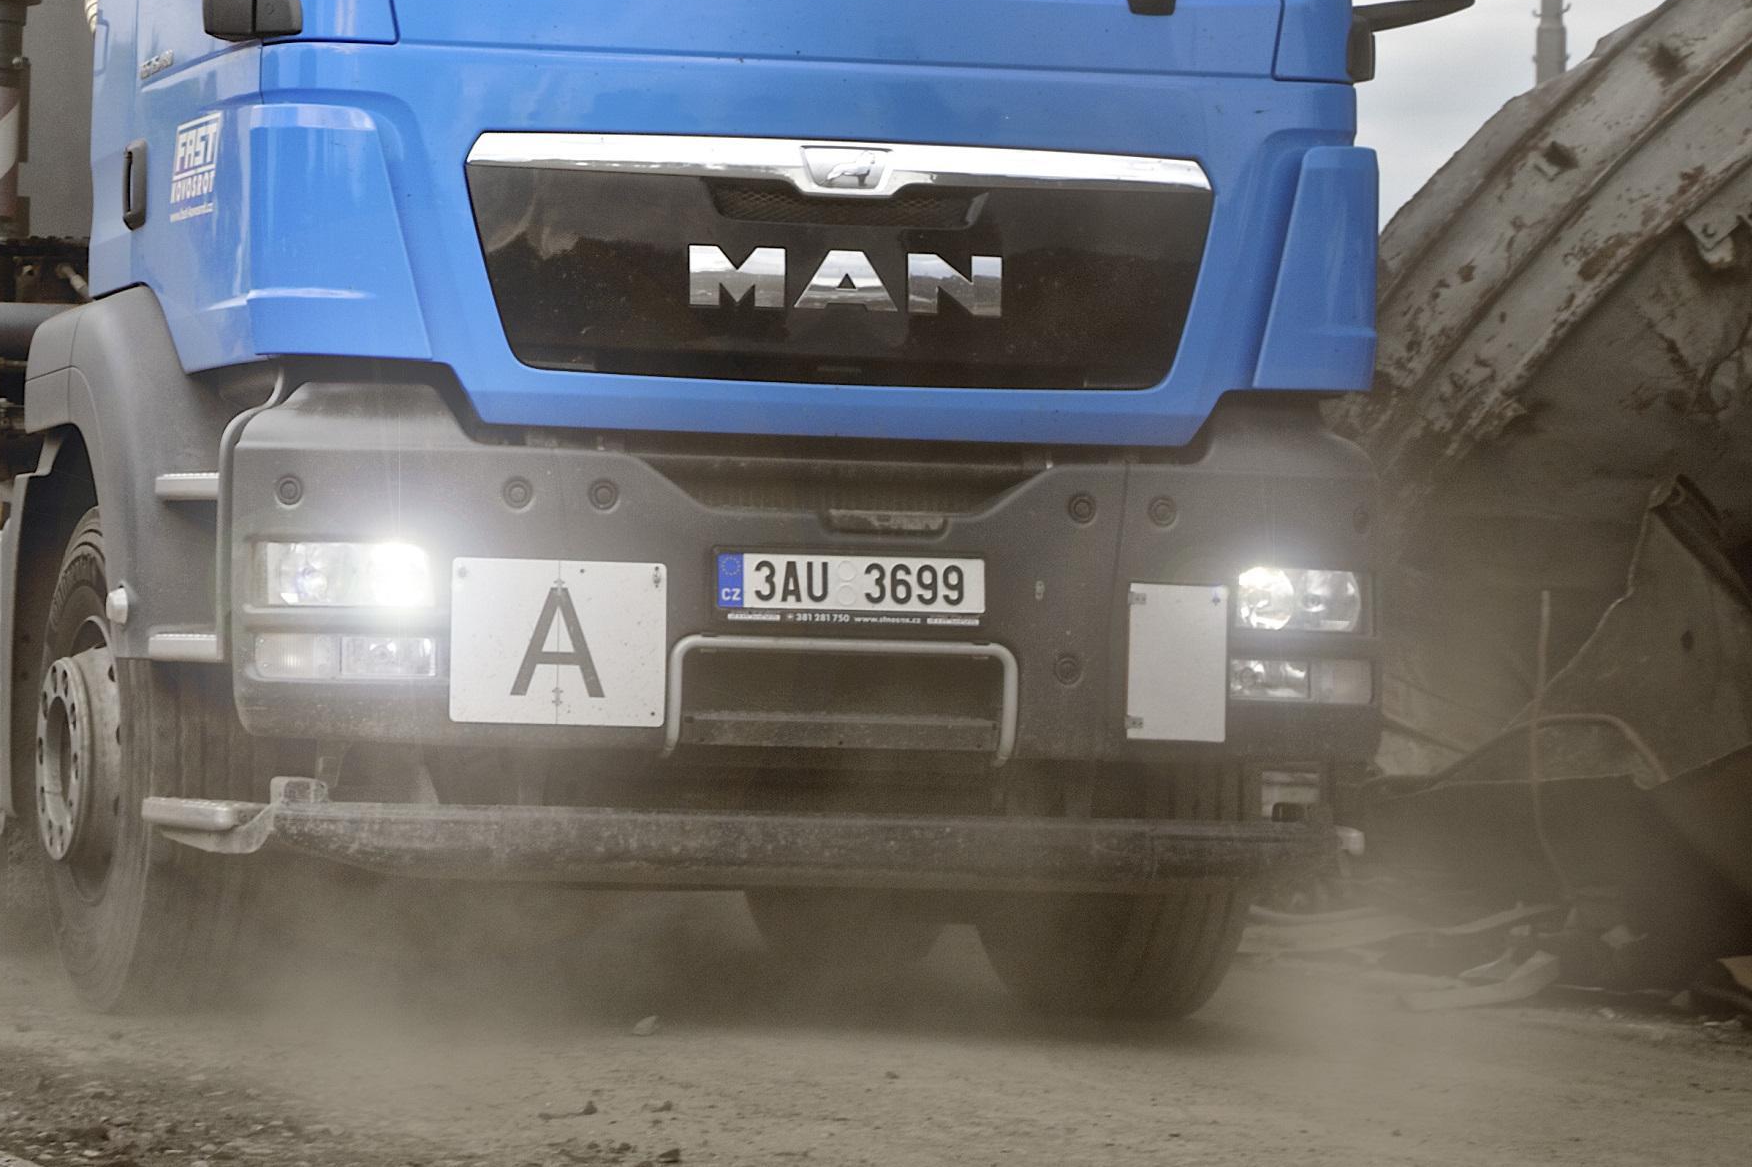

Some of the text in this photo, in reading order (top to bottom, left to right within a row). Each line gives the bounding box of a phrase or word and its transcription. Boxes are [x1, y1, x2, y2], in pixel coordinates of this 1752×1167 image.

[175, 122, 218, 172] FAST
[688, 244, 1003, 317] MAN
[721, 587, 742, 601] CZ
[753, 560, 965, 607] 3AU 3699
[833, 614, 851, 623] 750
[510, 587, 606, 699] A
